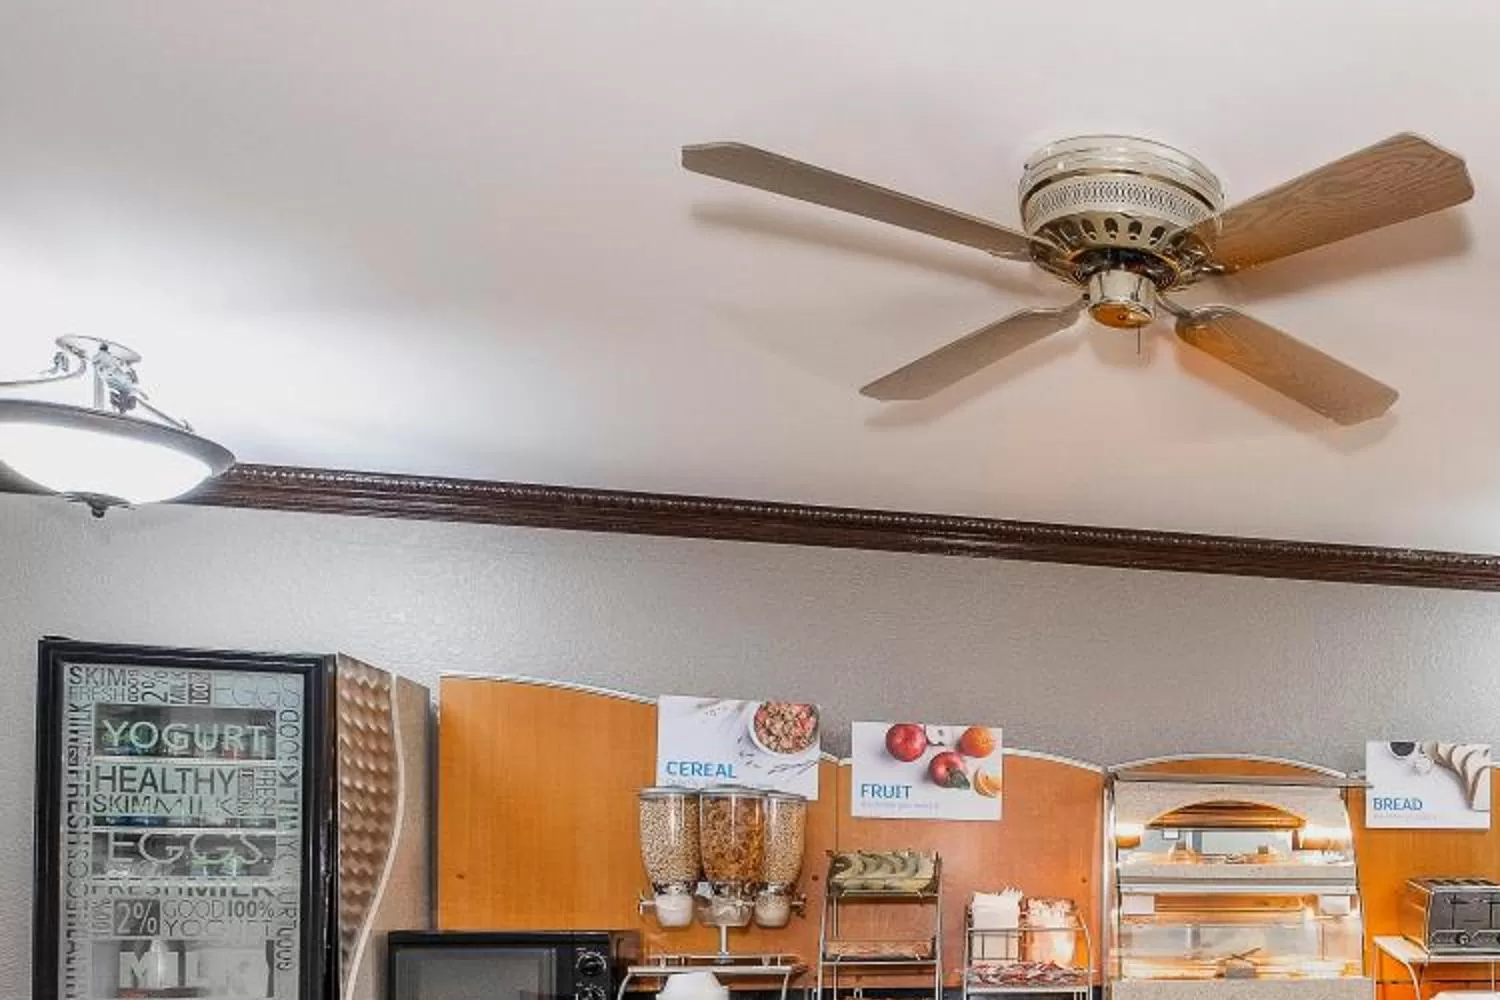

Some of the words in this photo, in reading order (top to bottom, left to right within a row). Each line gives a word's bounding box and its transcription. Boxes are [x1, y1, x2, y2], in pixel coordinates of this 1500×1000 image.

[70, 666, 128, 687] SKIM
[103, 719, 268, 752] YOGURT
[95, 766, 236, 795] HEALTHY
[666, 761, 737, 779] CEREAL
[861, 783, 913, 799] FRUIT
[92, 794, 152, 815] SKIM
[1373, 798, 1423, 811] BREAD
[109, 832, 263, 865] EGGS
[116, 901, 158, 935] 2%
